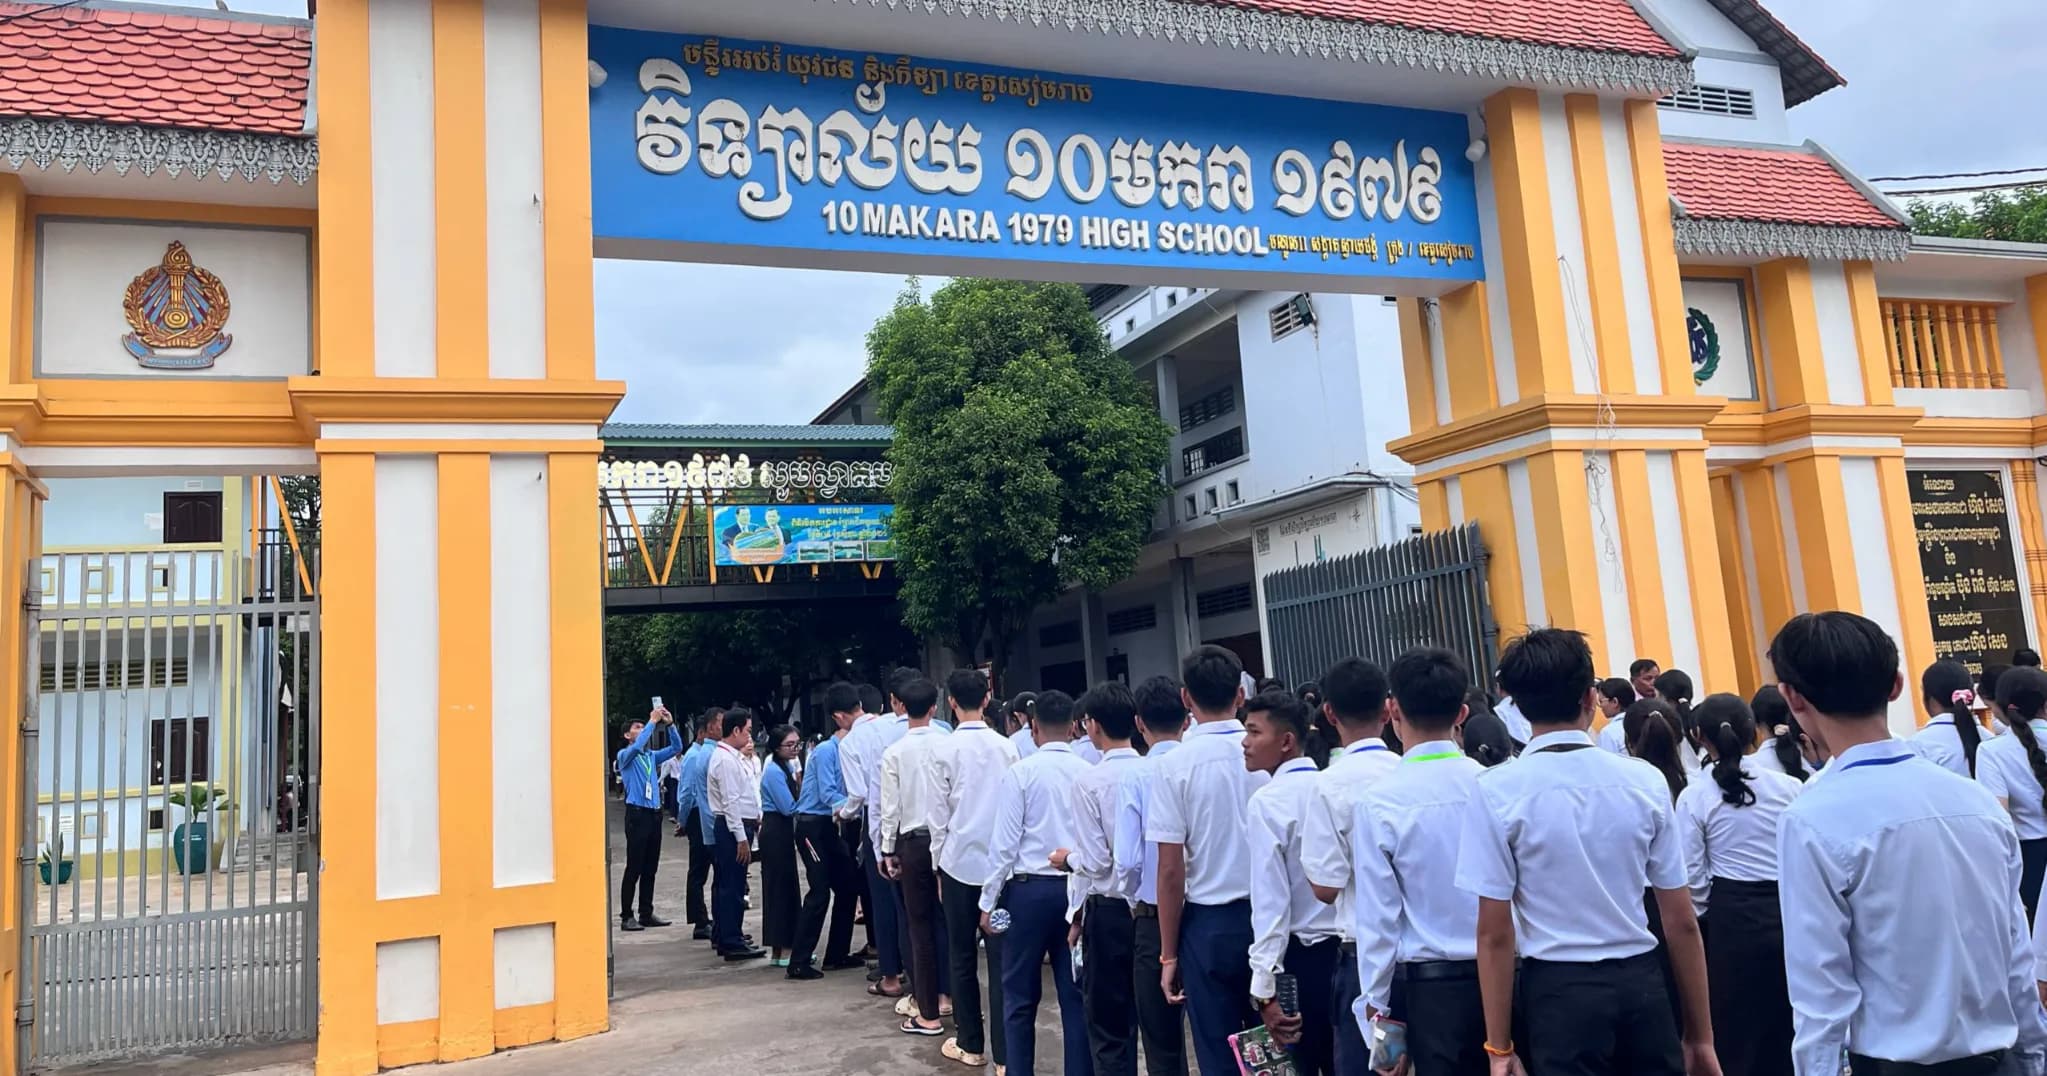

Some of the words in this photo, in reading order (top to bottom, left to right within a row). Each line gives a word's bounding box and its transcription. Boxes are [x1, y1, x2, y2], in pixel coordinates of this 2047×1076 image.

[787, 53, 854, 84] យុវជន
[635, 57, 984, 220] វិទ្យាល័យ
[1272, 138, 1443, 224] ១៩៧៩
[822, 199, 859, 234] 10
[863, 203, 1001, 242] MAKARA
[1007, 212, 1074, 246] 1979
[1080, 215, 1150, 251] HIGH
[1157, 222, 1269, 257] SCHOOL
